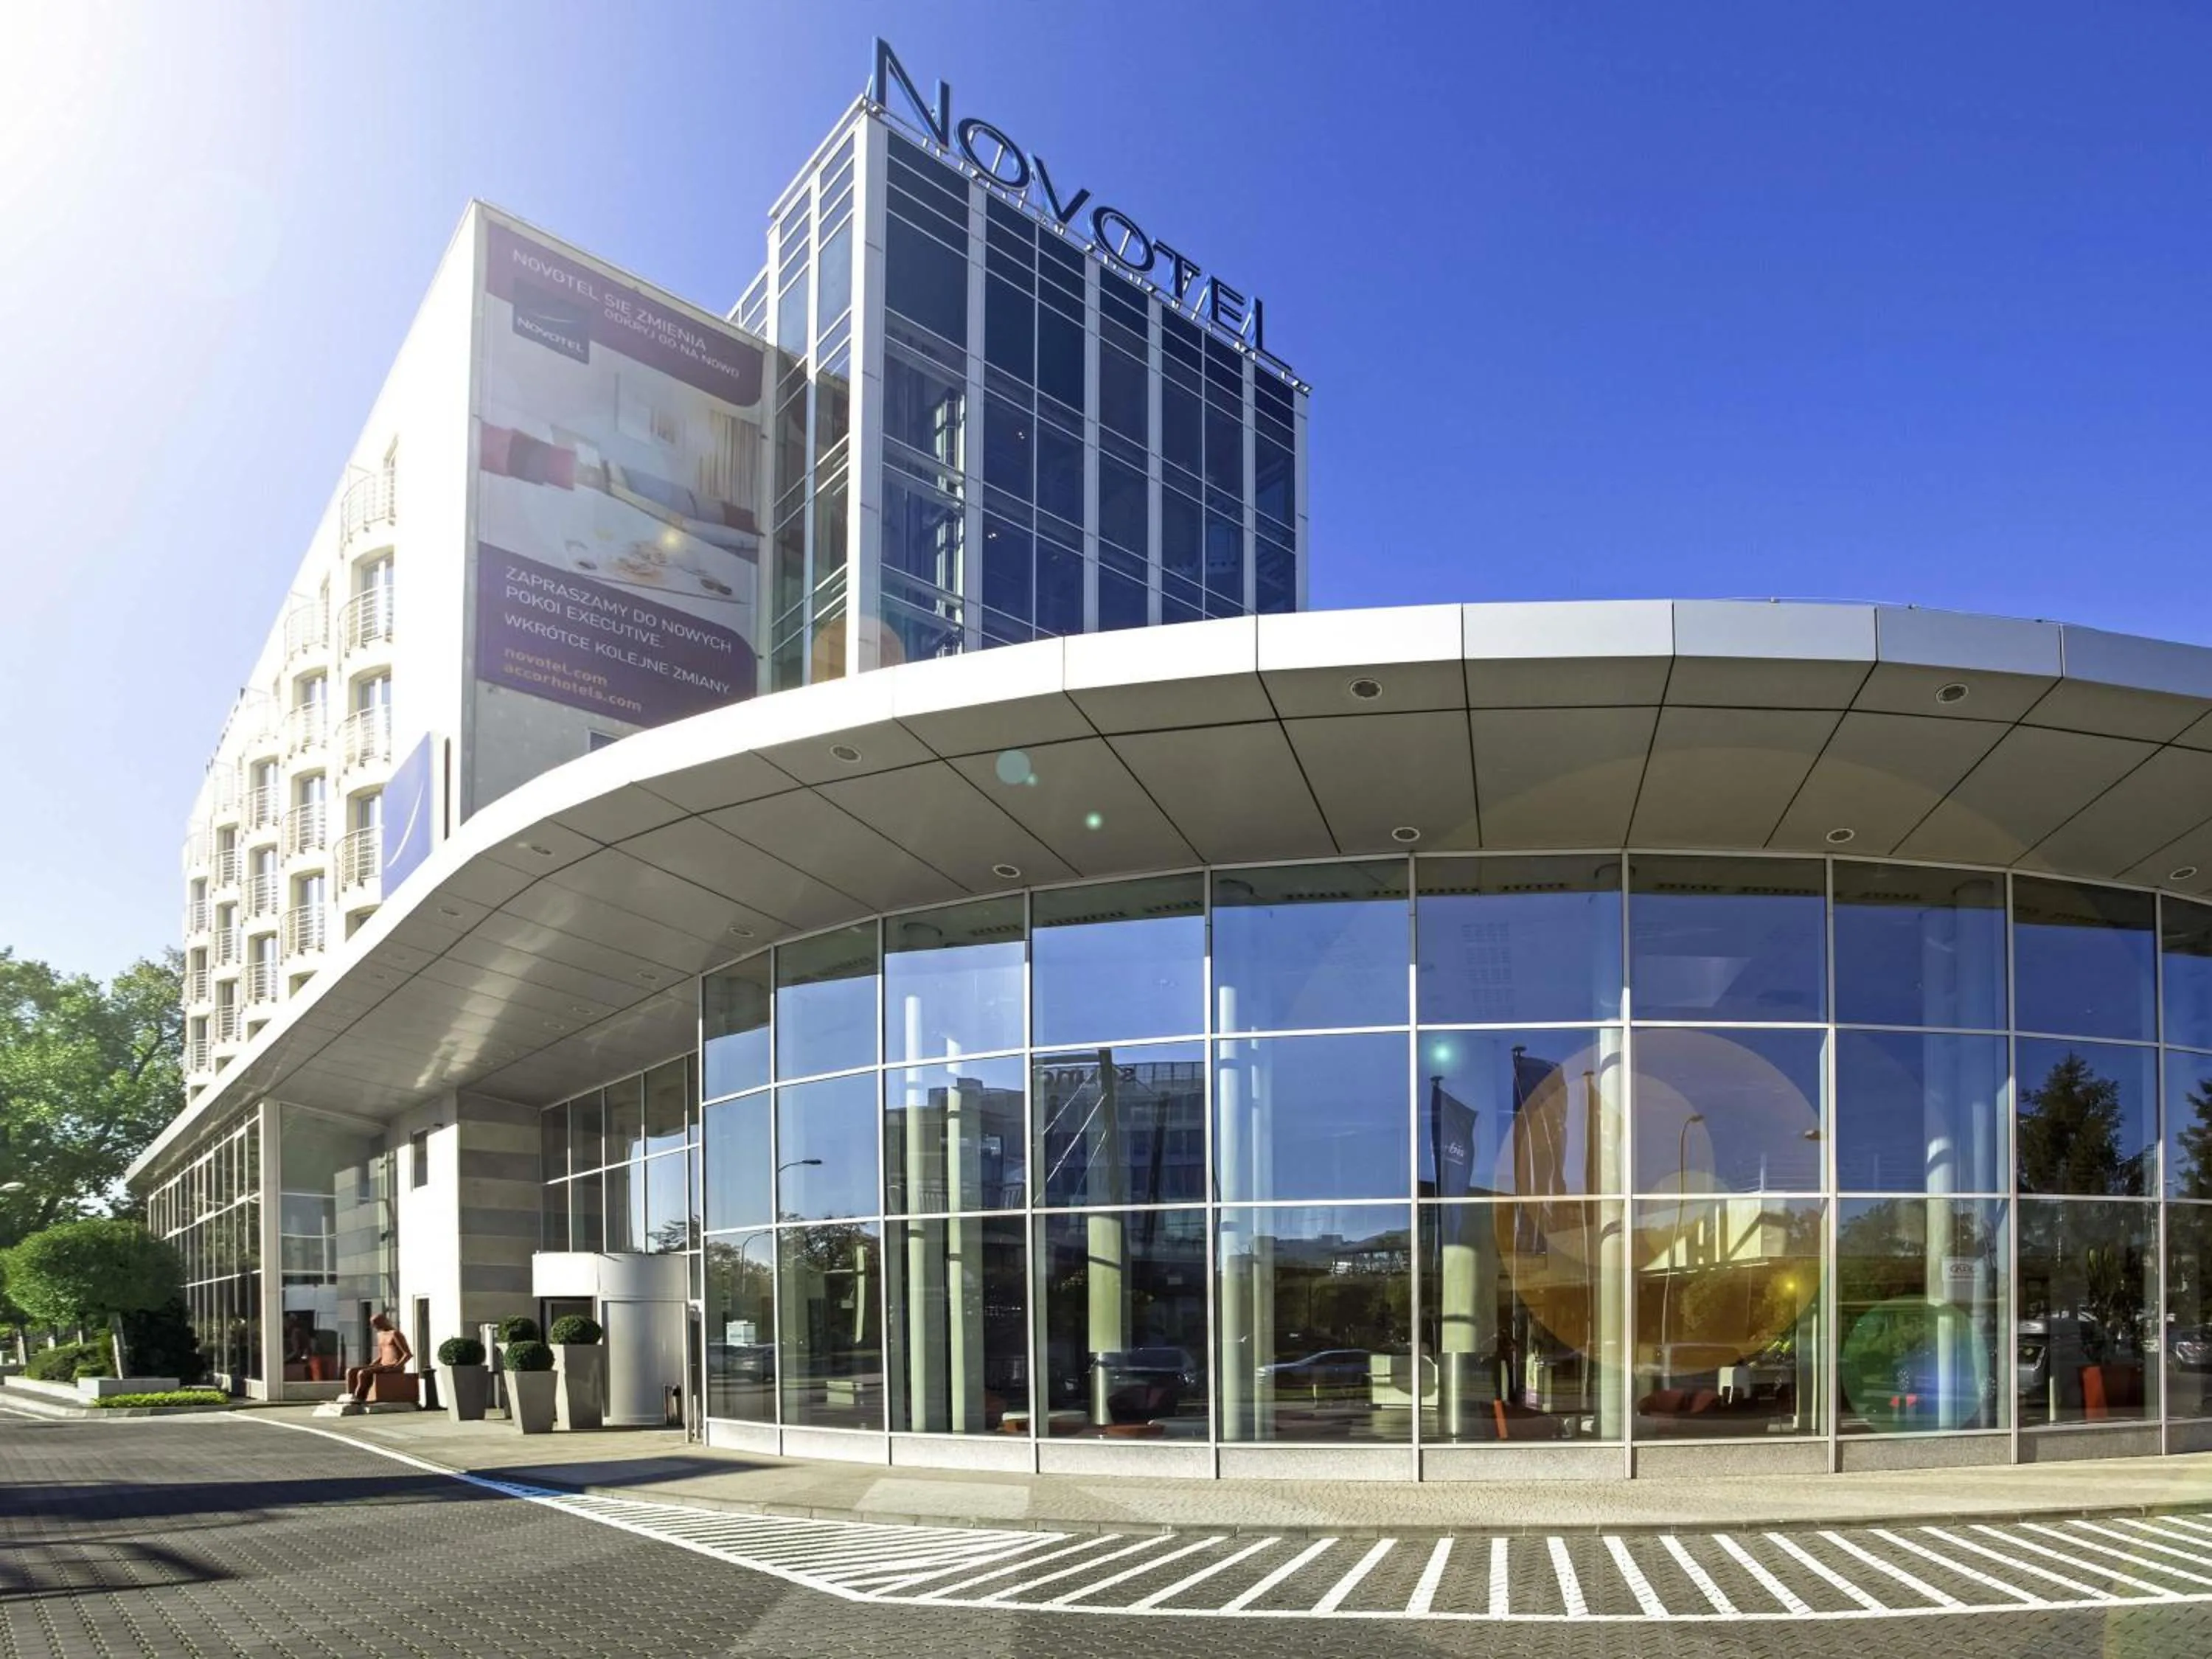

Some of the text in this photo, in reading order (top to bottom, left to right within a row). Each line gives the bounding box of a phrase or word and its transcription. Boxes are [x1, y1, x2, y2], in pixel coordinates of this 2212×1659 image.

[872, 35, 1293, 372] NOVOTEL
[512, 248, 600, 302] NOVOTEL
[636, 307, 706, 351] ZMIENIA
[517, 317, 584, 353] NOVOTEL
[680, 344, 699, 359] NA
[506, 585, 561, 614] POKOI
[506, 566, 732, 655] ZAPRASZAMY DO NOWYCH
[504, 611, 731, 695] WKRÓTCE KOLEJNE ZMIANY
[504, 647, 608, 687] novotel.com
[504, 664, 643, 713] accorhotels.com
